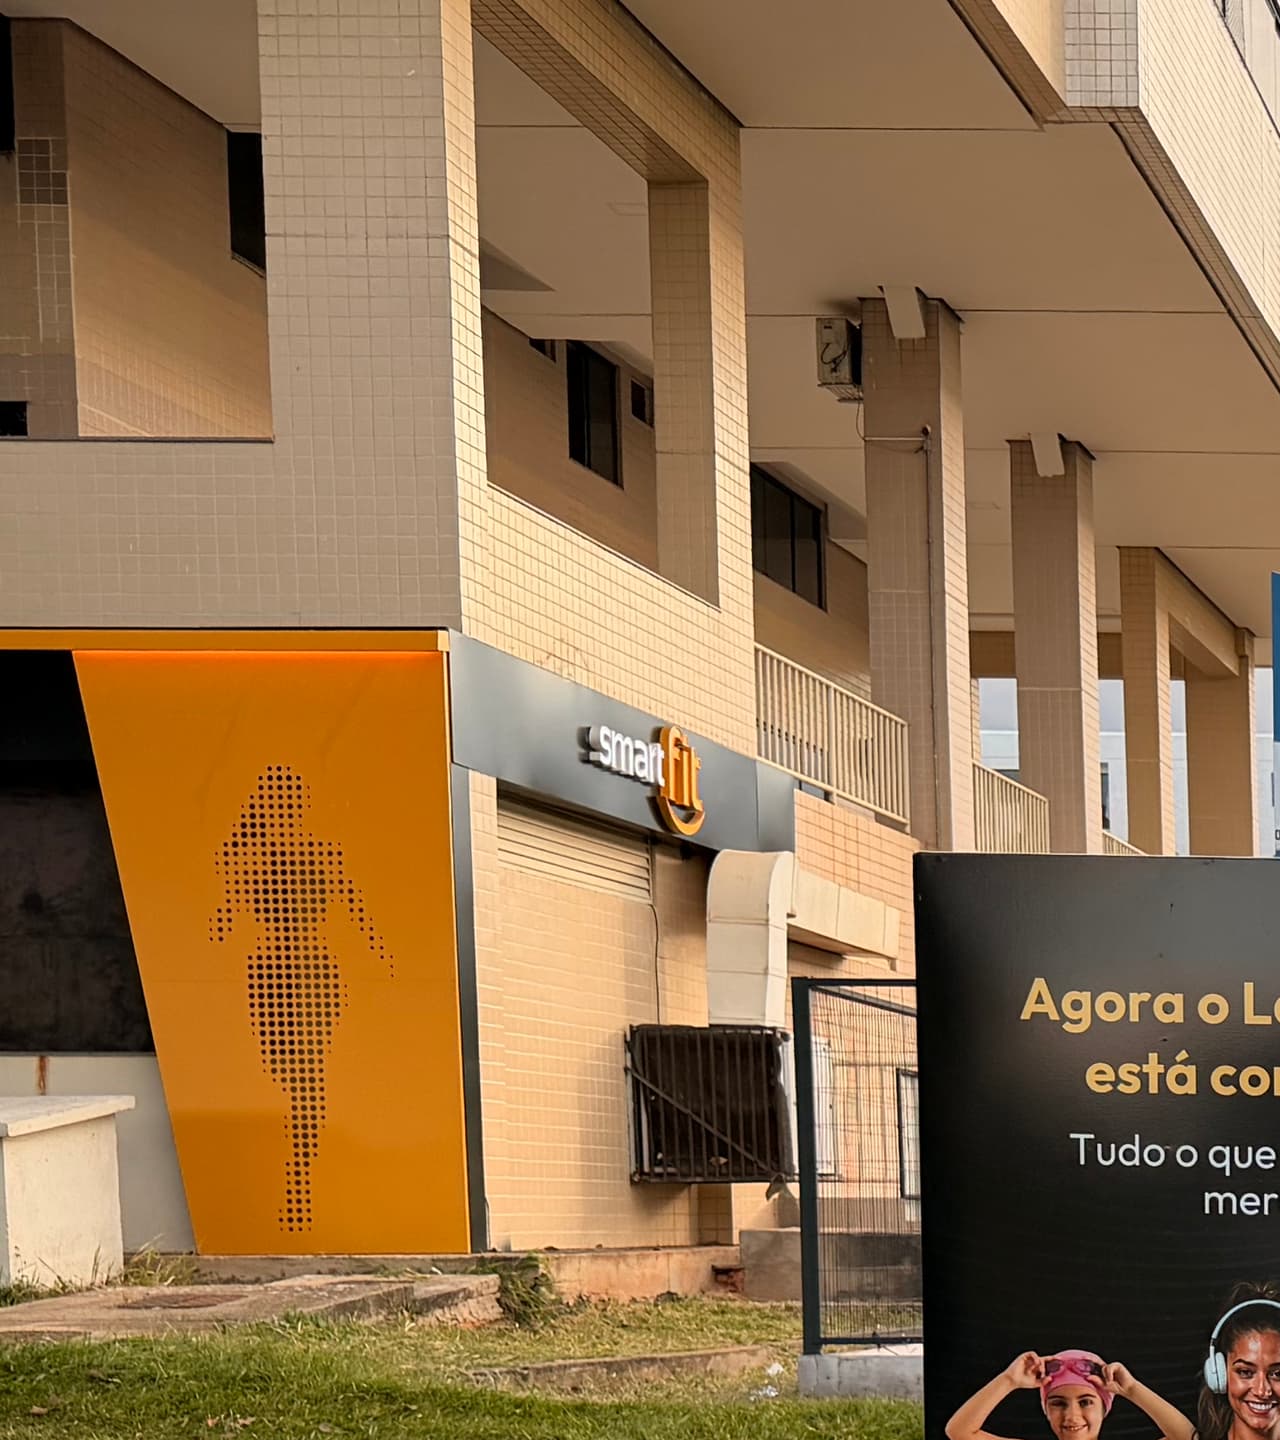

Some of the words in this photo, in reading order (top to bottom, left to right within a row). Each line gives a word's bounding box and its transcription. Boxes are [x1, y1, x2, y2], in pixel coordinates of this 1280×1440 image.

[598, 725, 665, 787] smart
[661, 726, 702, 812] fit
[1019, 977, 1185, 1034] Agora
[1197, 992, 1230, 1025] o
[1085, 1049, 1198, 1096] está
[1069, 1132, 1164, 1168] Tudo
[1175, 1145, 1199, 1170] o
[1207, 1146, 1277, 1177] que
